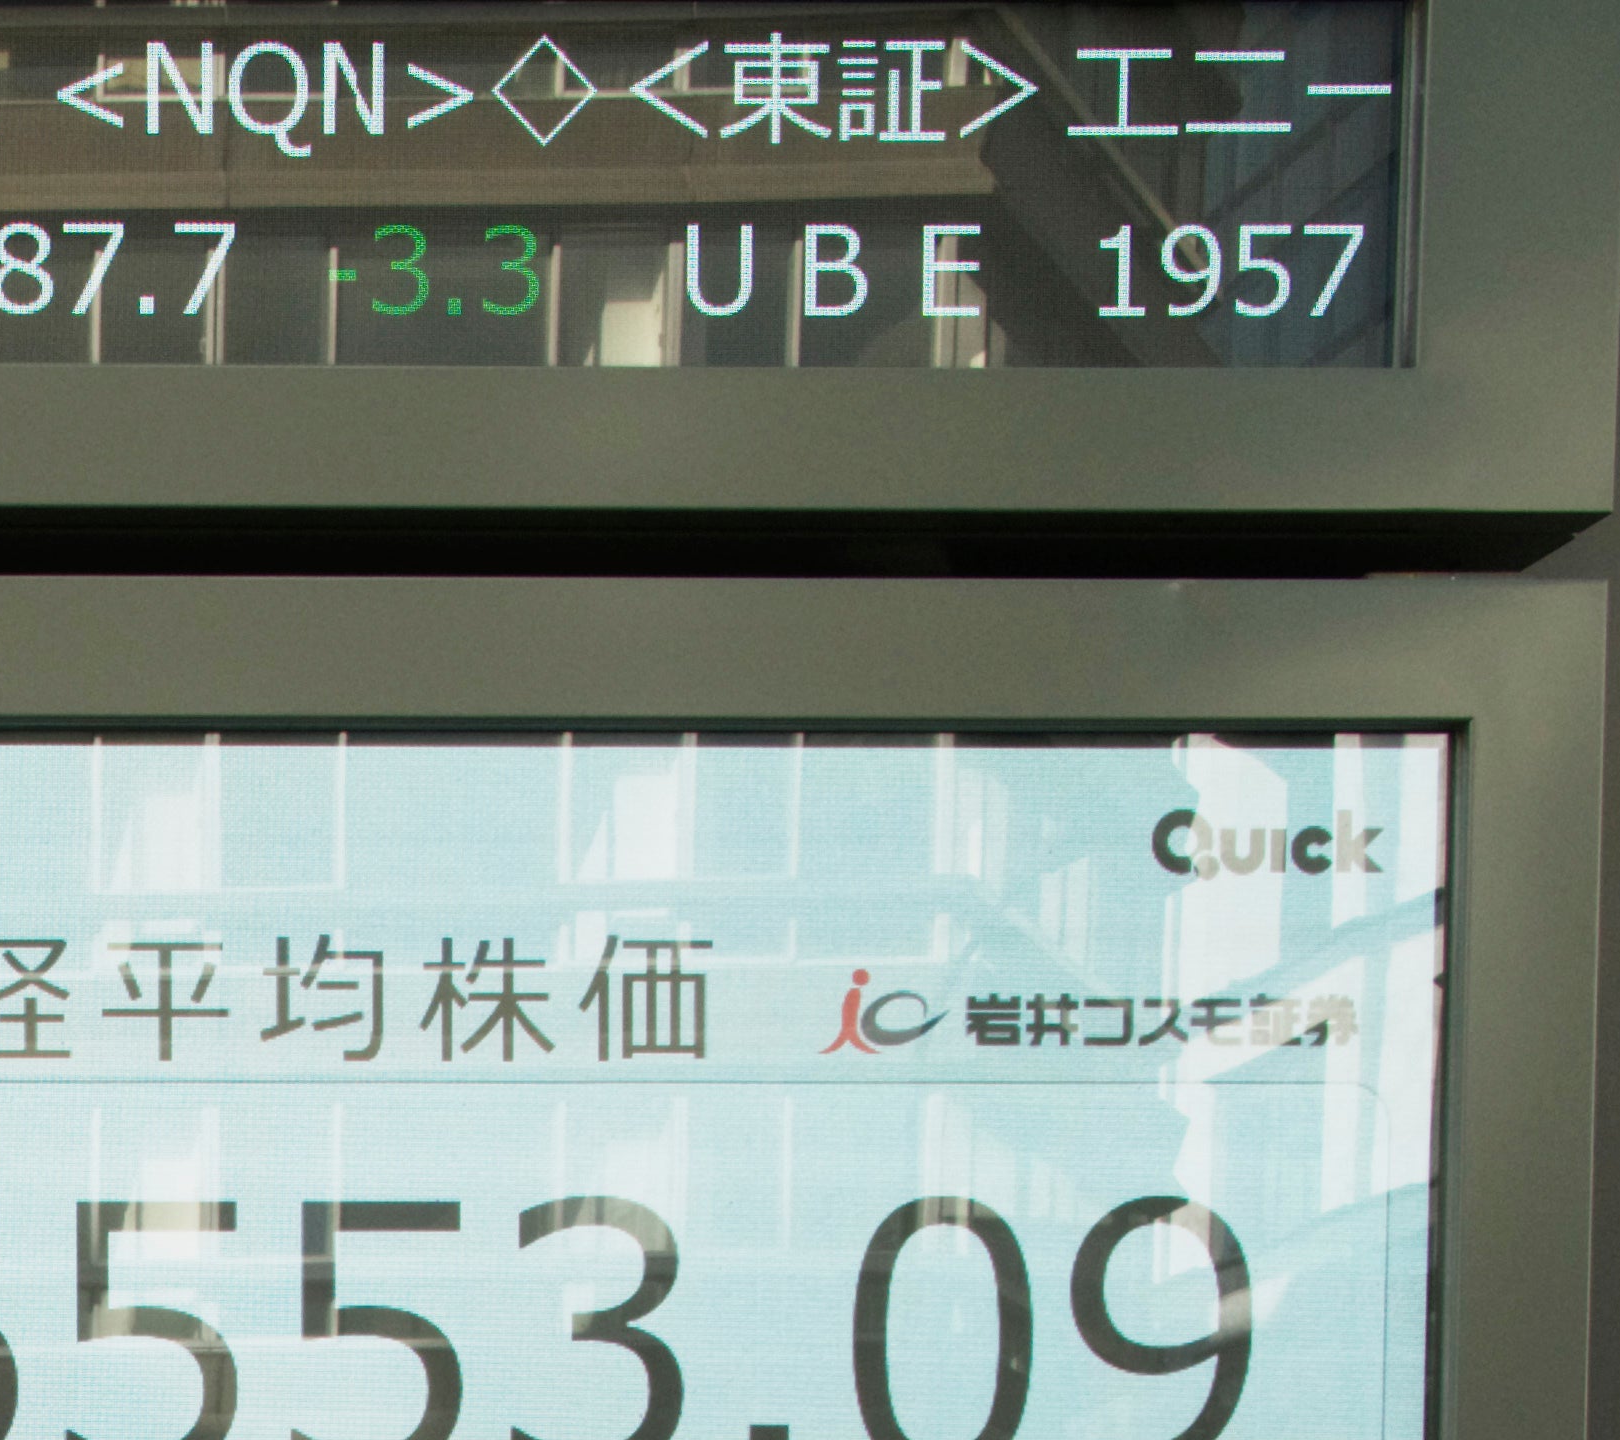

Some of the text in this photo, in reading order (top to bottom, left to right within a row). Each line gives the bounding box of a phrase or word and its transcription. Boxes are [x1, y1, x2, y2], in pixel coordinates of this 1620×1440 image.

[328, 224, 540, 316] -3.3
[1098, 223, 1365, 318] 1957
[965, 992, 1360, 1047] 岩井コスモ証券
